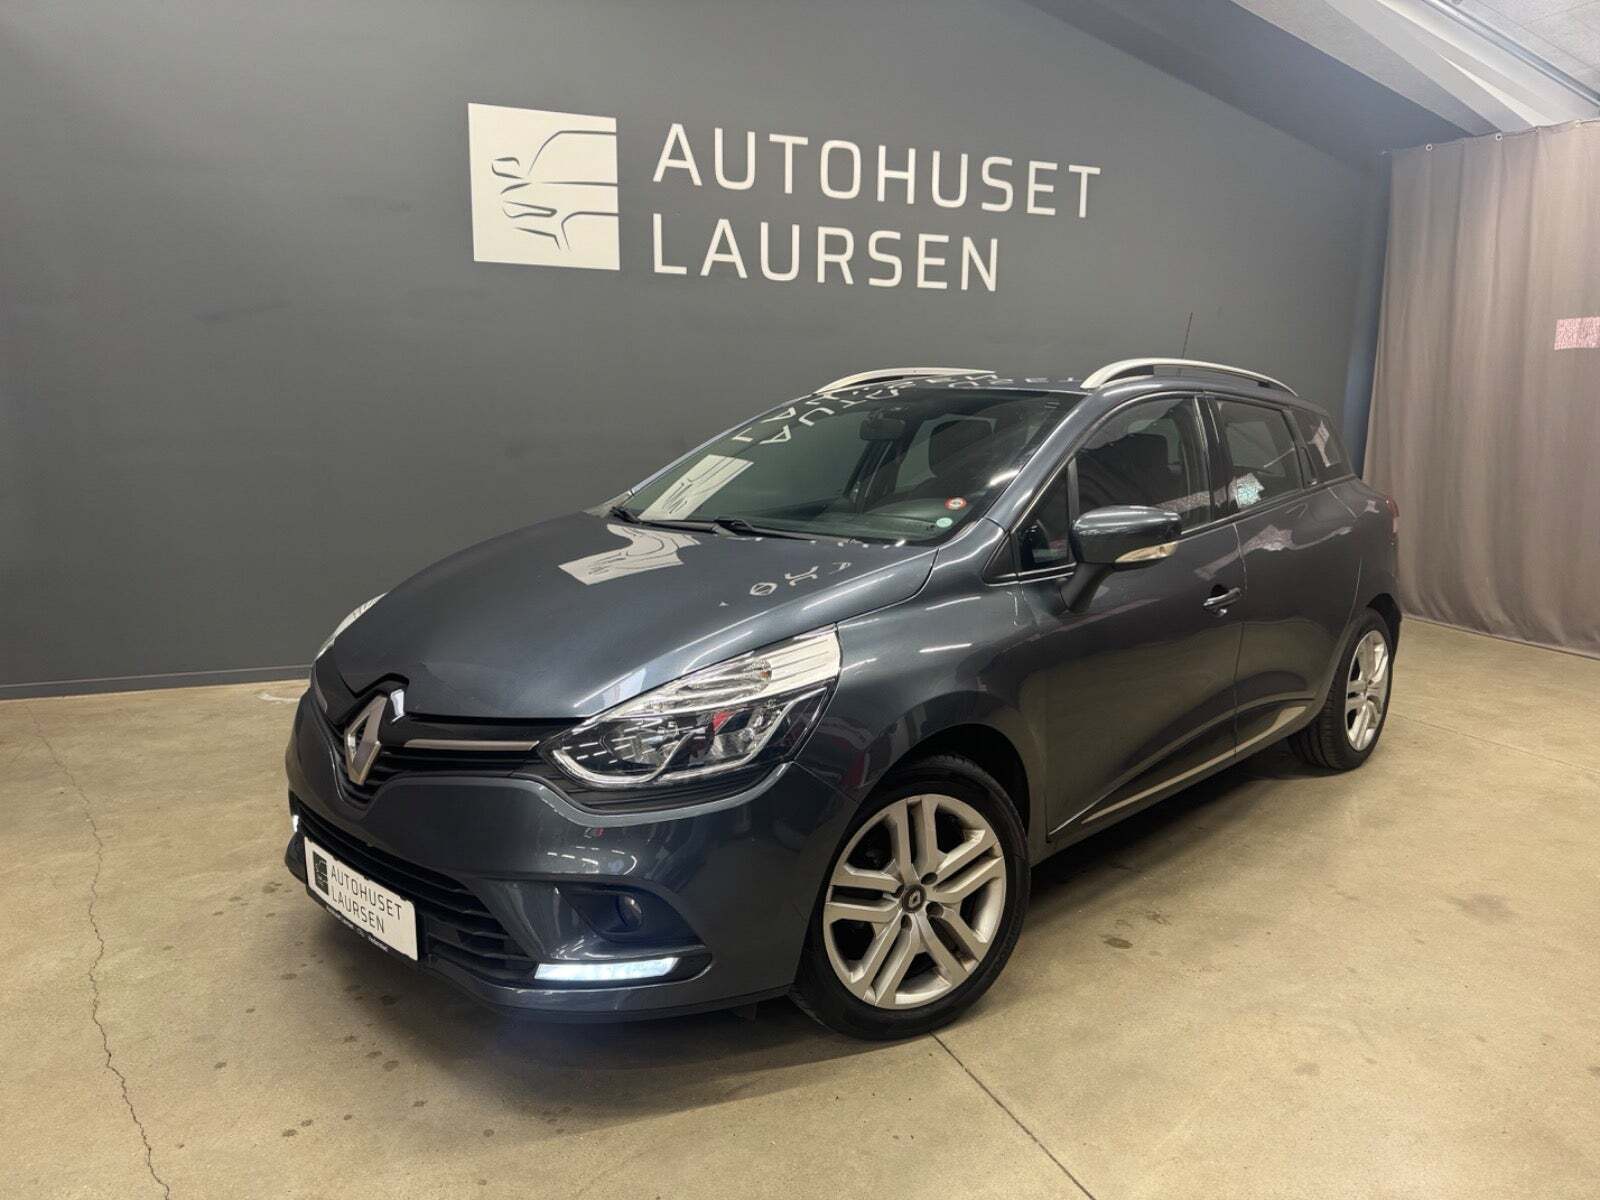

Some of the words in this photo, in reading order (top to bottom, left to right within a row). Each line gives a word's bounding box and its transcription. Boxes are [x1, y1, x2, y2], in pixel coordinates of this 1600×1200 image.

[652, 122, 1101, 218] AUTOHUSET
[652, 212, 998, 292] LAURSEN
[331, 865, 402, 920] AUTOHUSET
[331, 885, 385, 934] LAURSEN
